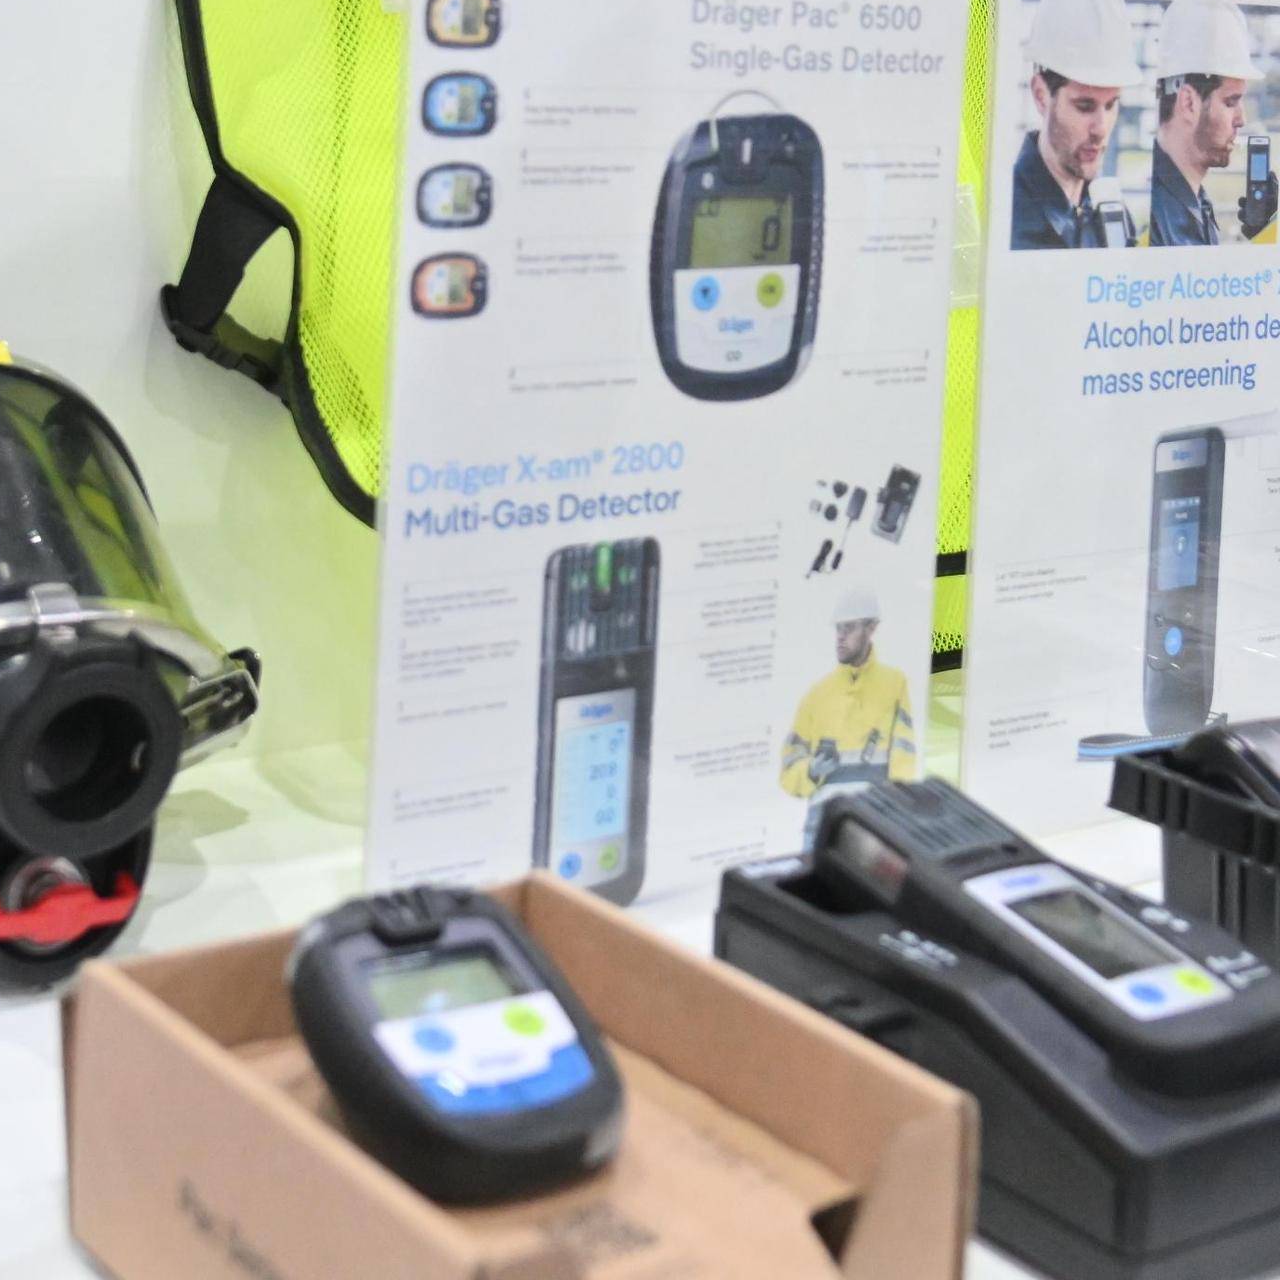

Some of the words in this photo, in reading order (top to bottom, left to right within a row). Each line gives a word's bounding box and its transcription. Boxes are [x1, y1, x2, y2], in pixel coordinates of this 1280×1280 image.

[859, 4, 923, 31] 6500
[689, 42, 832, 77] Single-Gas
[841, 44, 944, 74] Detector
[1086, 275, 1165, 308] Dräger
[1083, 318, 1173, 350] Alcohol
[1179, 313, 1249, 343] breath
[1081, 370, 1143, 396] mass
[1149, 359, 1257, 392] screening
[406, 464, 508, 498] Dräger
[611, 441, 686, 475] 2800
[403, 497, 551, 538] Multi-Gas
[557, 485, 682, 523] Detector
